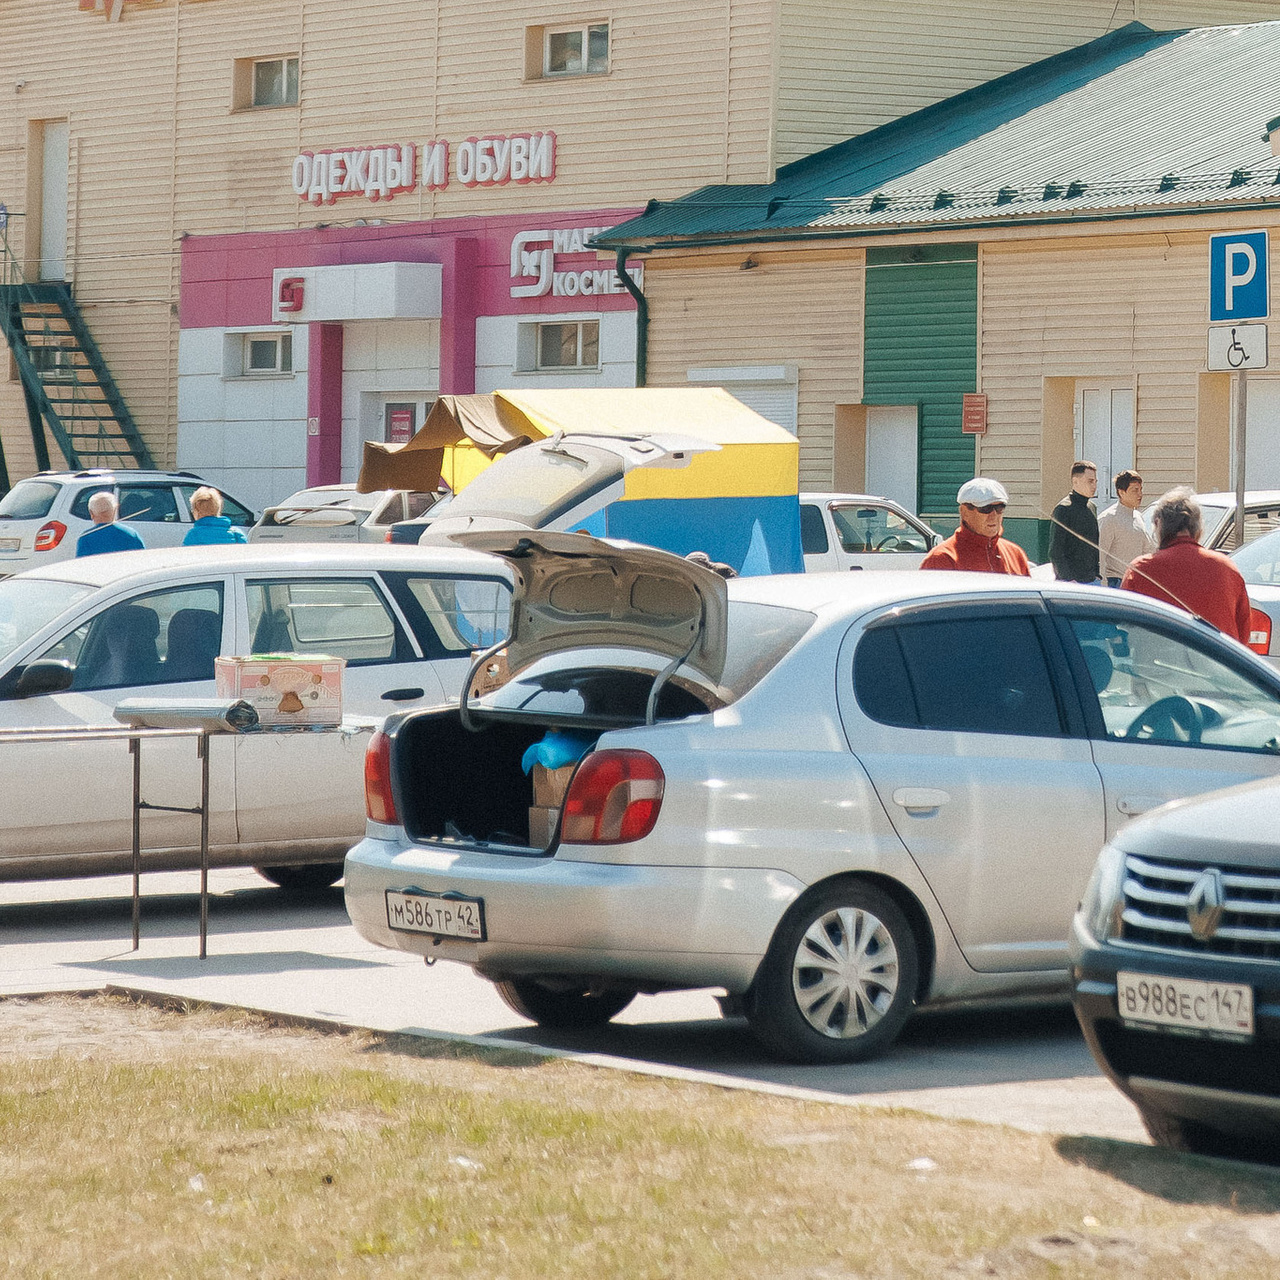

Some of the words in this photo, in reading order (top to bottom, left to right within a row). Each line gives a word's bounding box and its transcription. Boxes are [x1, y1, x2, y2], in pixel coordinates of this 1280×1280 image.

[291, 143, 416, 204] ОДЕЖДЫ
[422, 140, 449, 190] И
[456, 131, 556, 187] ОБУВИ
[1225, 242, 1257, 311] P
[394, 900, 452, 931] М586ТР
[457, 904, 474, 926] 42
[1125, 980, 1206, 1021] В988ЕС
[1210, 987, 1243, 1017] 147
